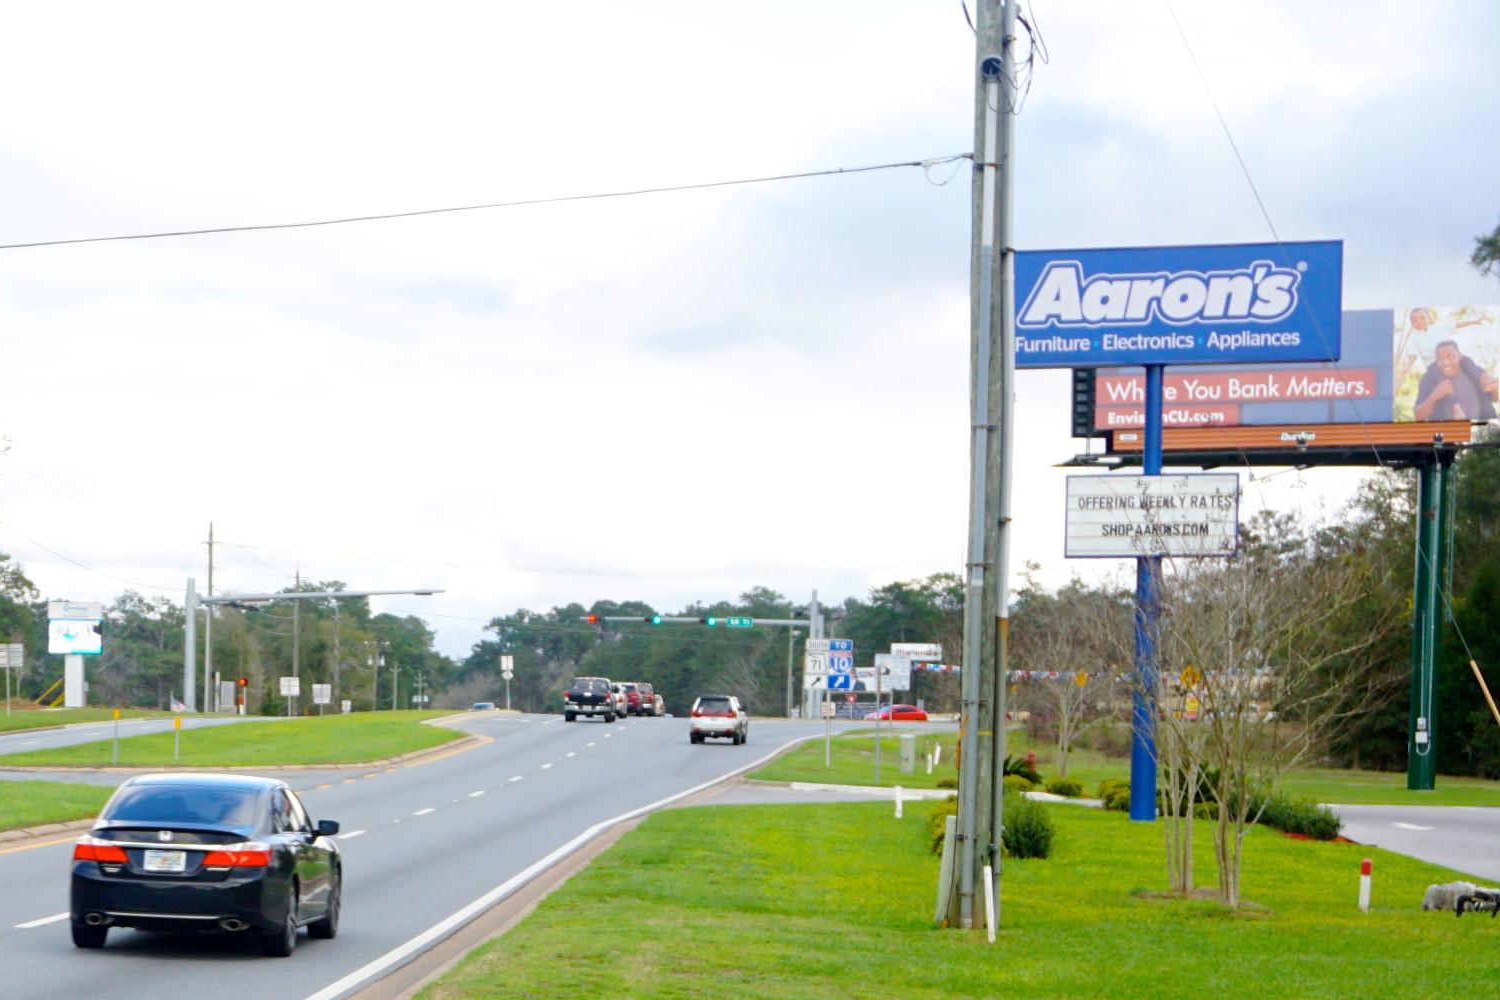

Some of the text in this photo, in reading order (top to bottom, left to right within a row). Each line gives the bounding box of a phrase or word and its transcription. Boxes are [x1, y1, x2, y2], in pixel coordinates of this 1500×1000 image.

[1018, 261, 1299, 327] Aaron's
[1015, 331, 1300, 352] Furniture Electronics Appliances
[1106, 374, 1370, 401] Whe You Bank Matters.
[1078, 495, 1232, 509] OFFERING WEEKLY RATES
[808, 641, 828, 649] SOUTH
[835, 641, 848, 649] TO
[811, 659, 821, 670] 71
[833, 656, 849, 671] 10
